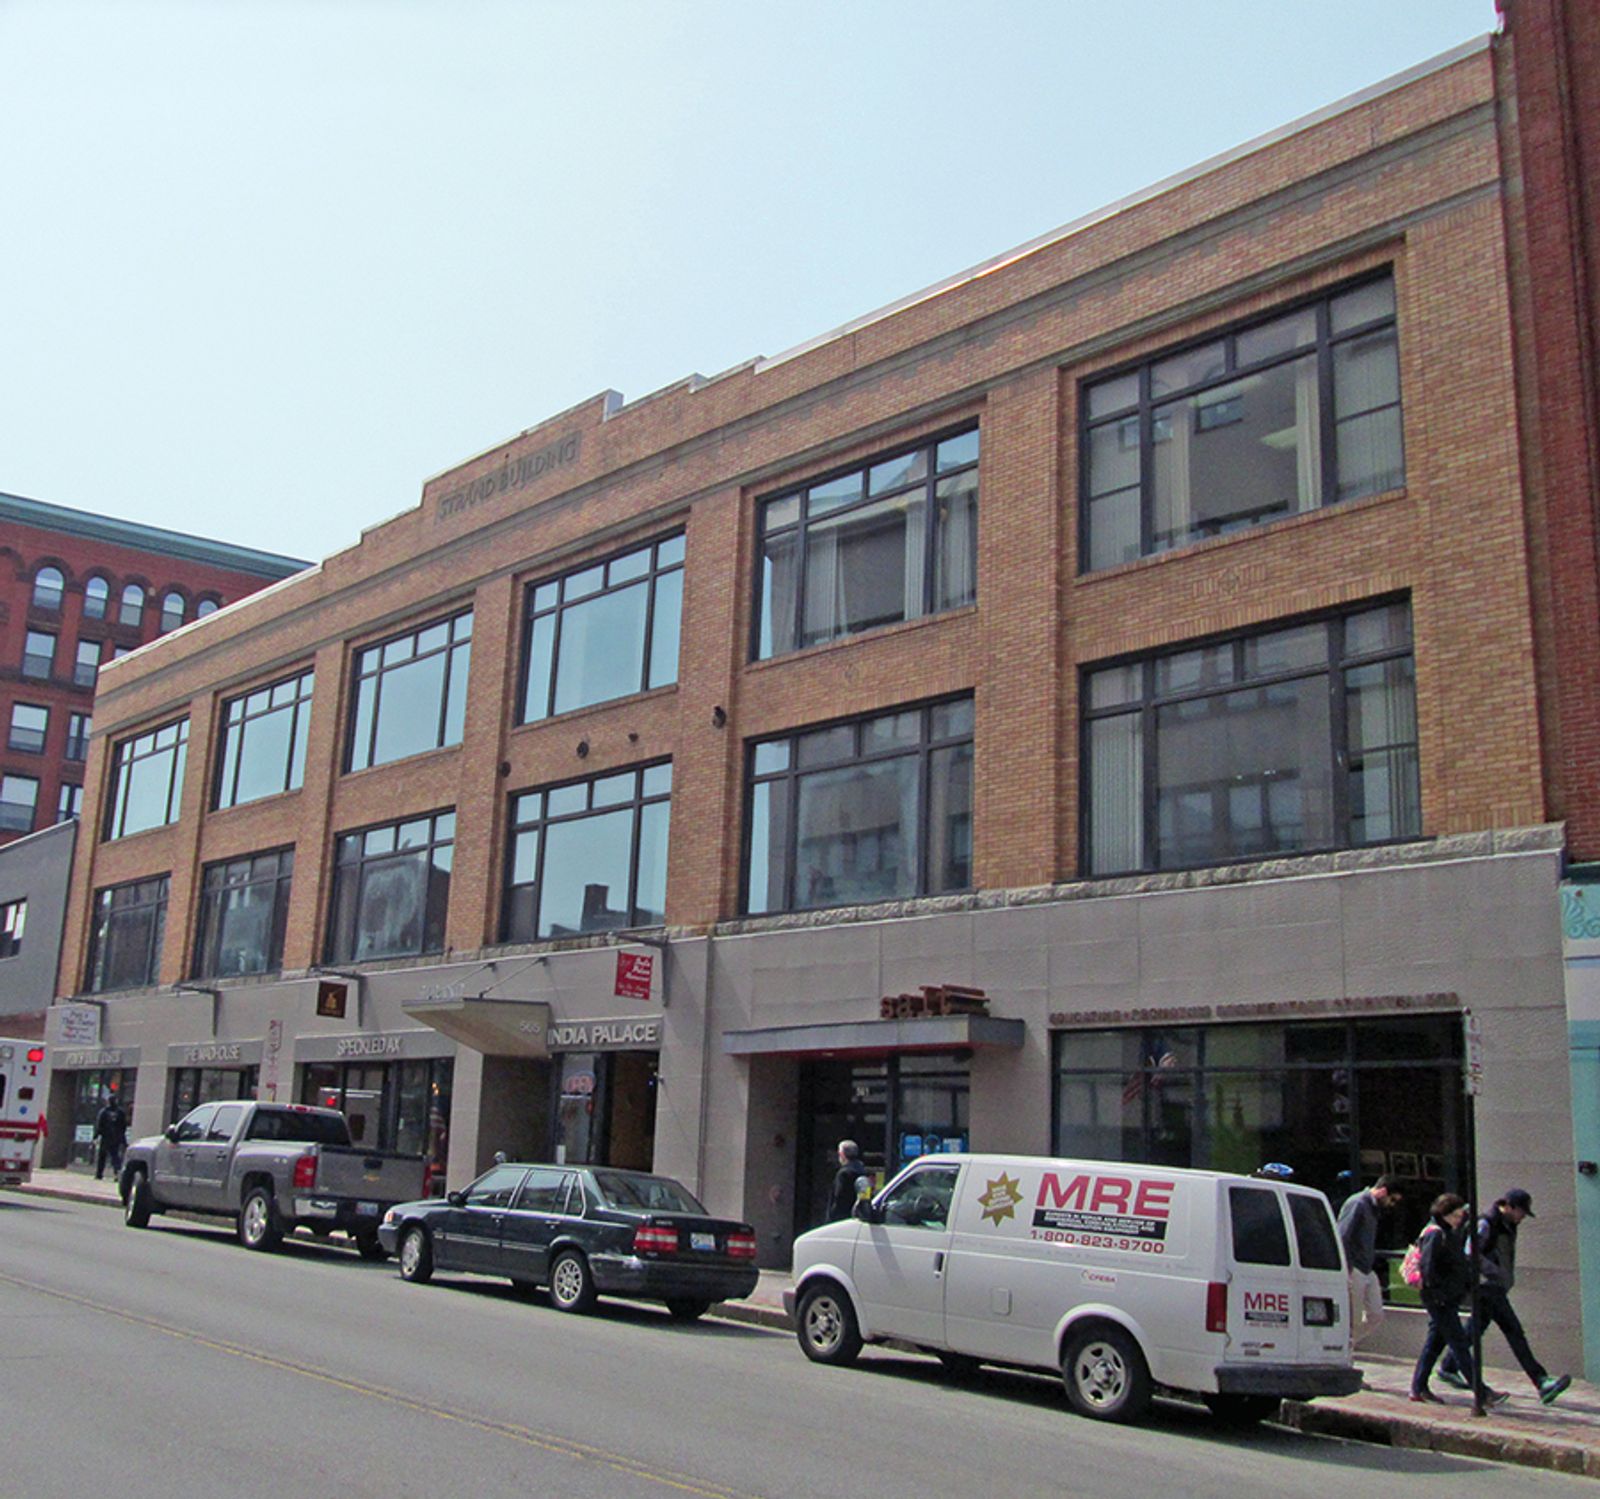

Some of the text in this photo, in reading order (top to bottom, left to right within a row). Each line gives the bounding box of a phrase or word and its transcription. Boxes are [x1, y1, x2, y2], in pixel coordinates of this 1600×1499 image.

[440, 438, 578, 519] STRAND BUILDING
[592, 1023, 657, 1043] PALACE
[1036, 1172, 1175, 1218] MRE
[1244, 1292, 1289, 1312] MRE
